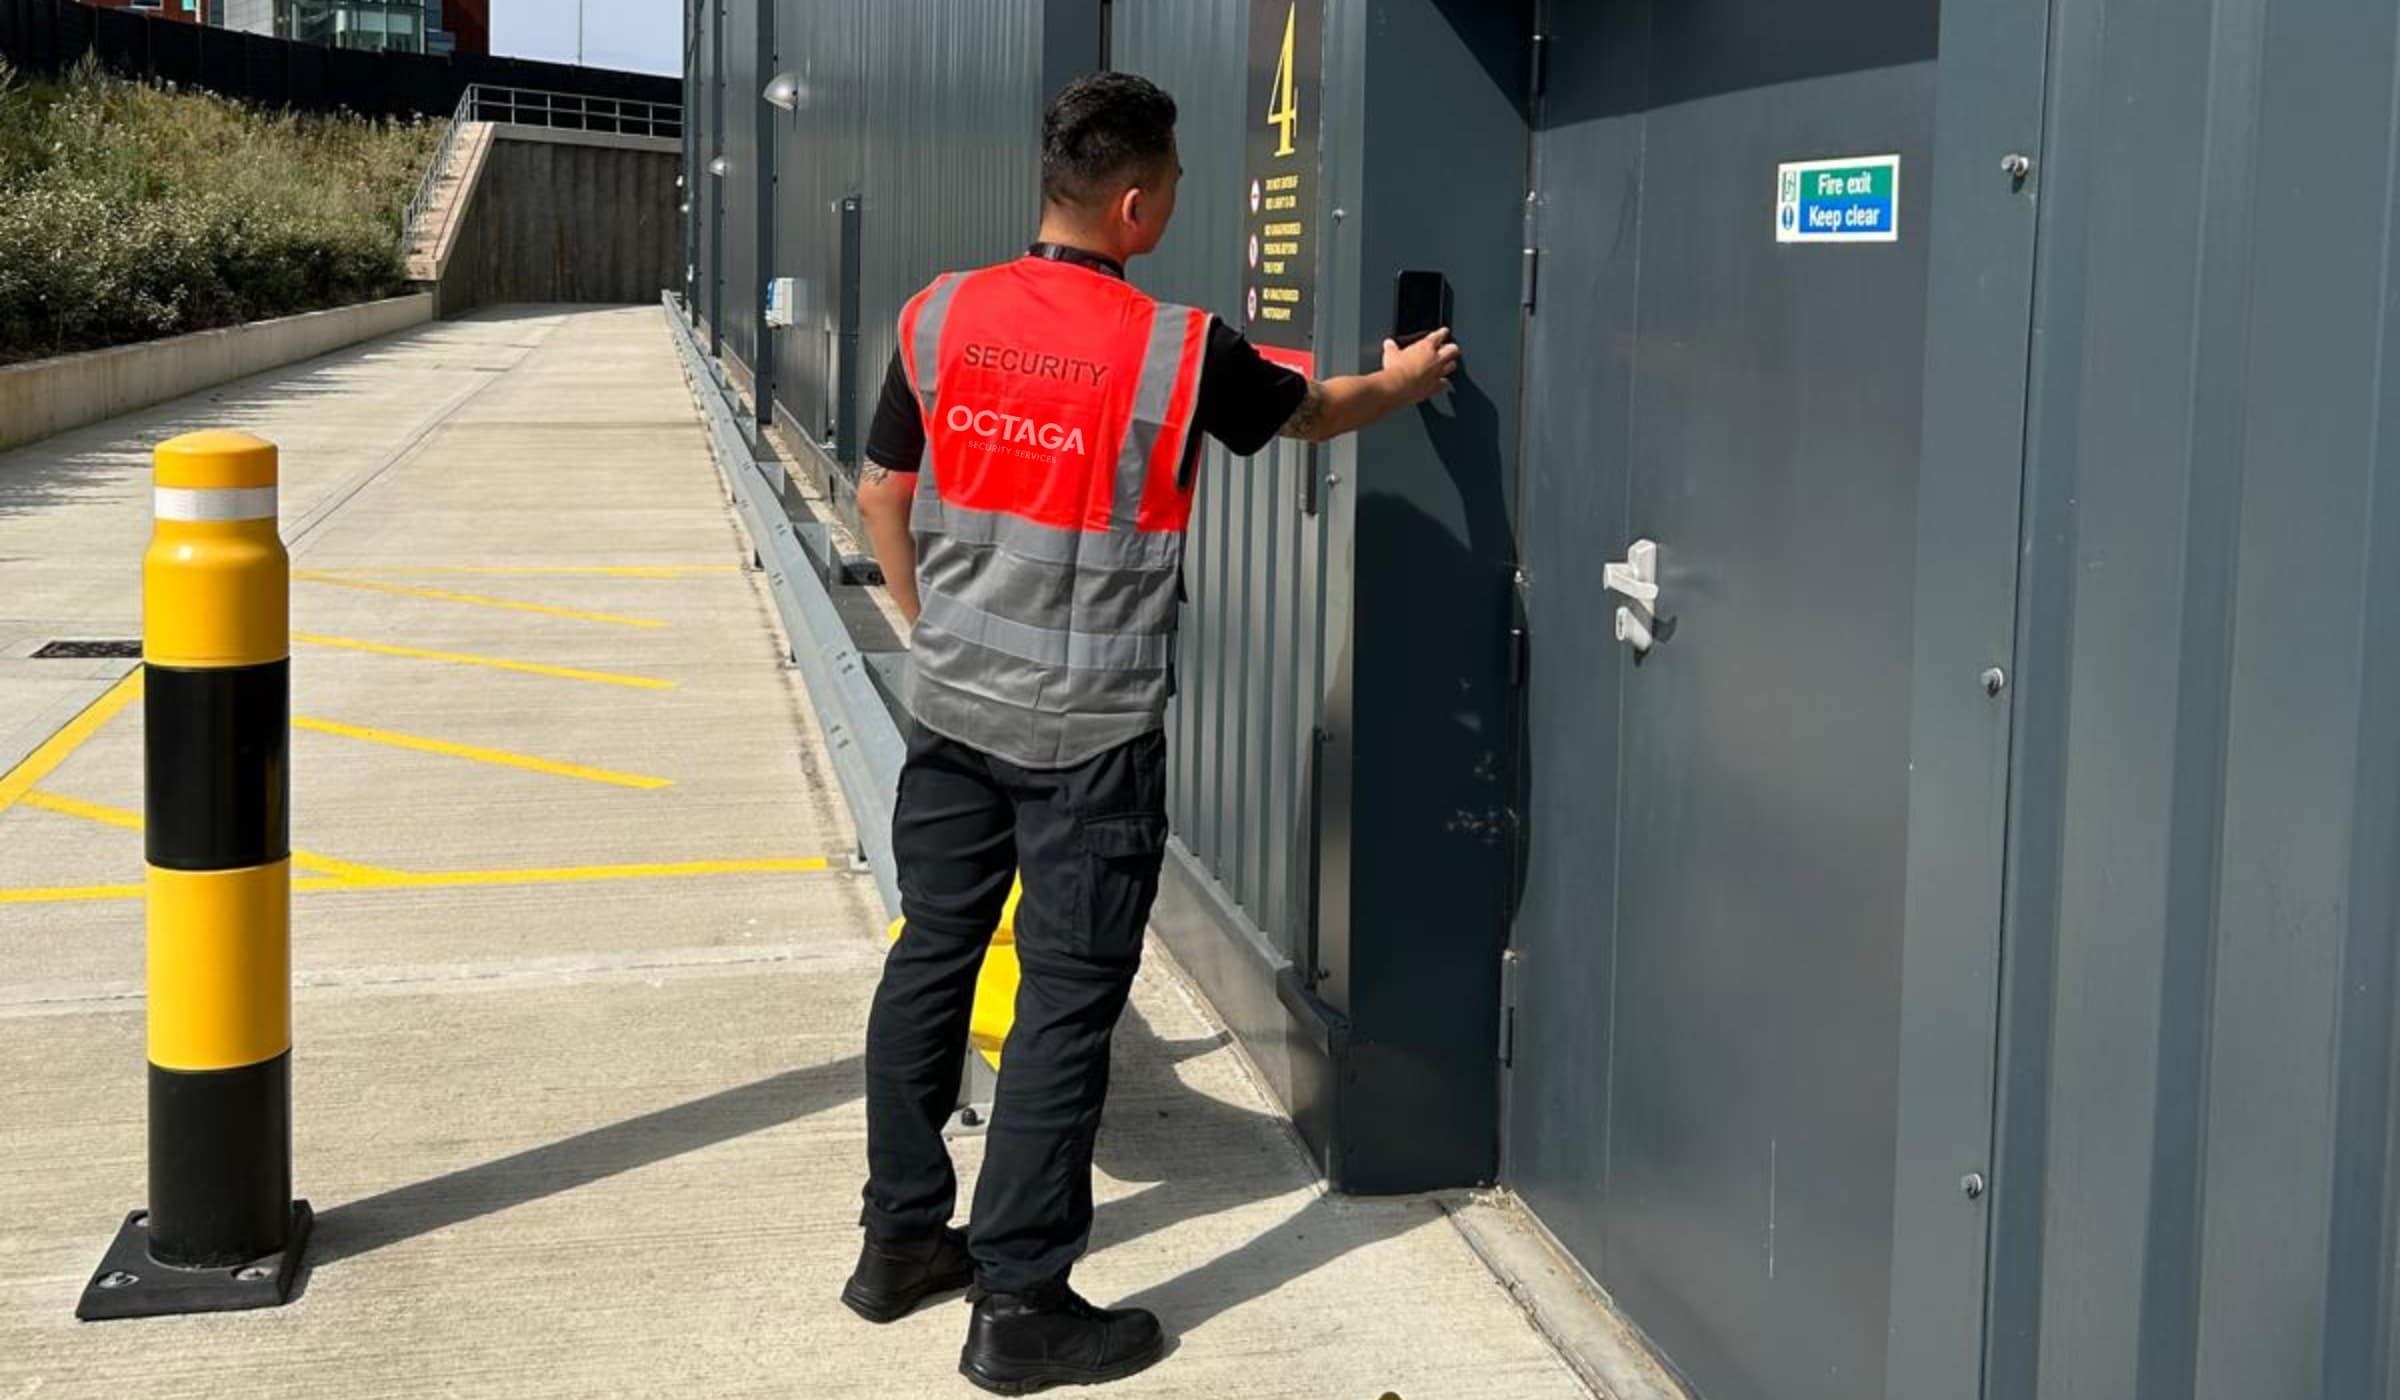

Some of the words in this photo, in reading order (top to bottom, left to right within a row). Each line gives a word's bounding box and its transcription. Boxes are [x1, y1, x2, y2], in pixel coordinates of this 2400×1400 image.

[1267, 1, 1298, 157] 4
[1818, 173, 1844, 196] Fire
[1847, 171, 1872, 194] exit
[1808, 205, 1842, 231] Keep
[1845, 204, 1880, 227] clear
[964, 343, 1108, 387] SECURITY
[947, 404, 1086, 456] OCTAGA
[967, 440, 1012, 455] SECURITY
[1015, 449, 1058, 464] SERVICES
